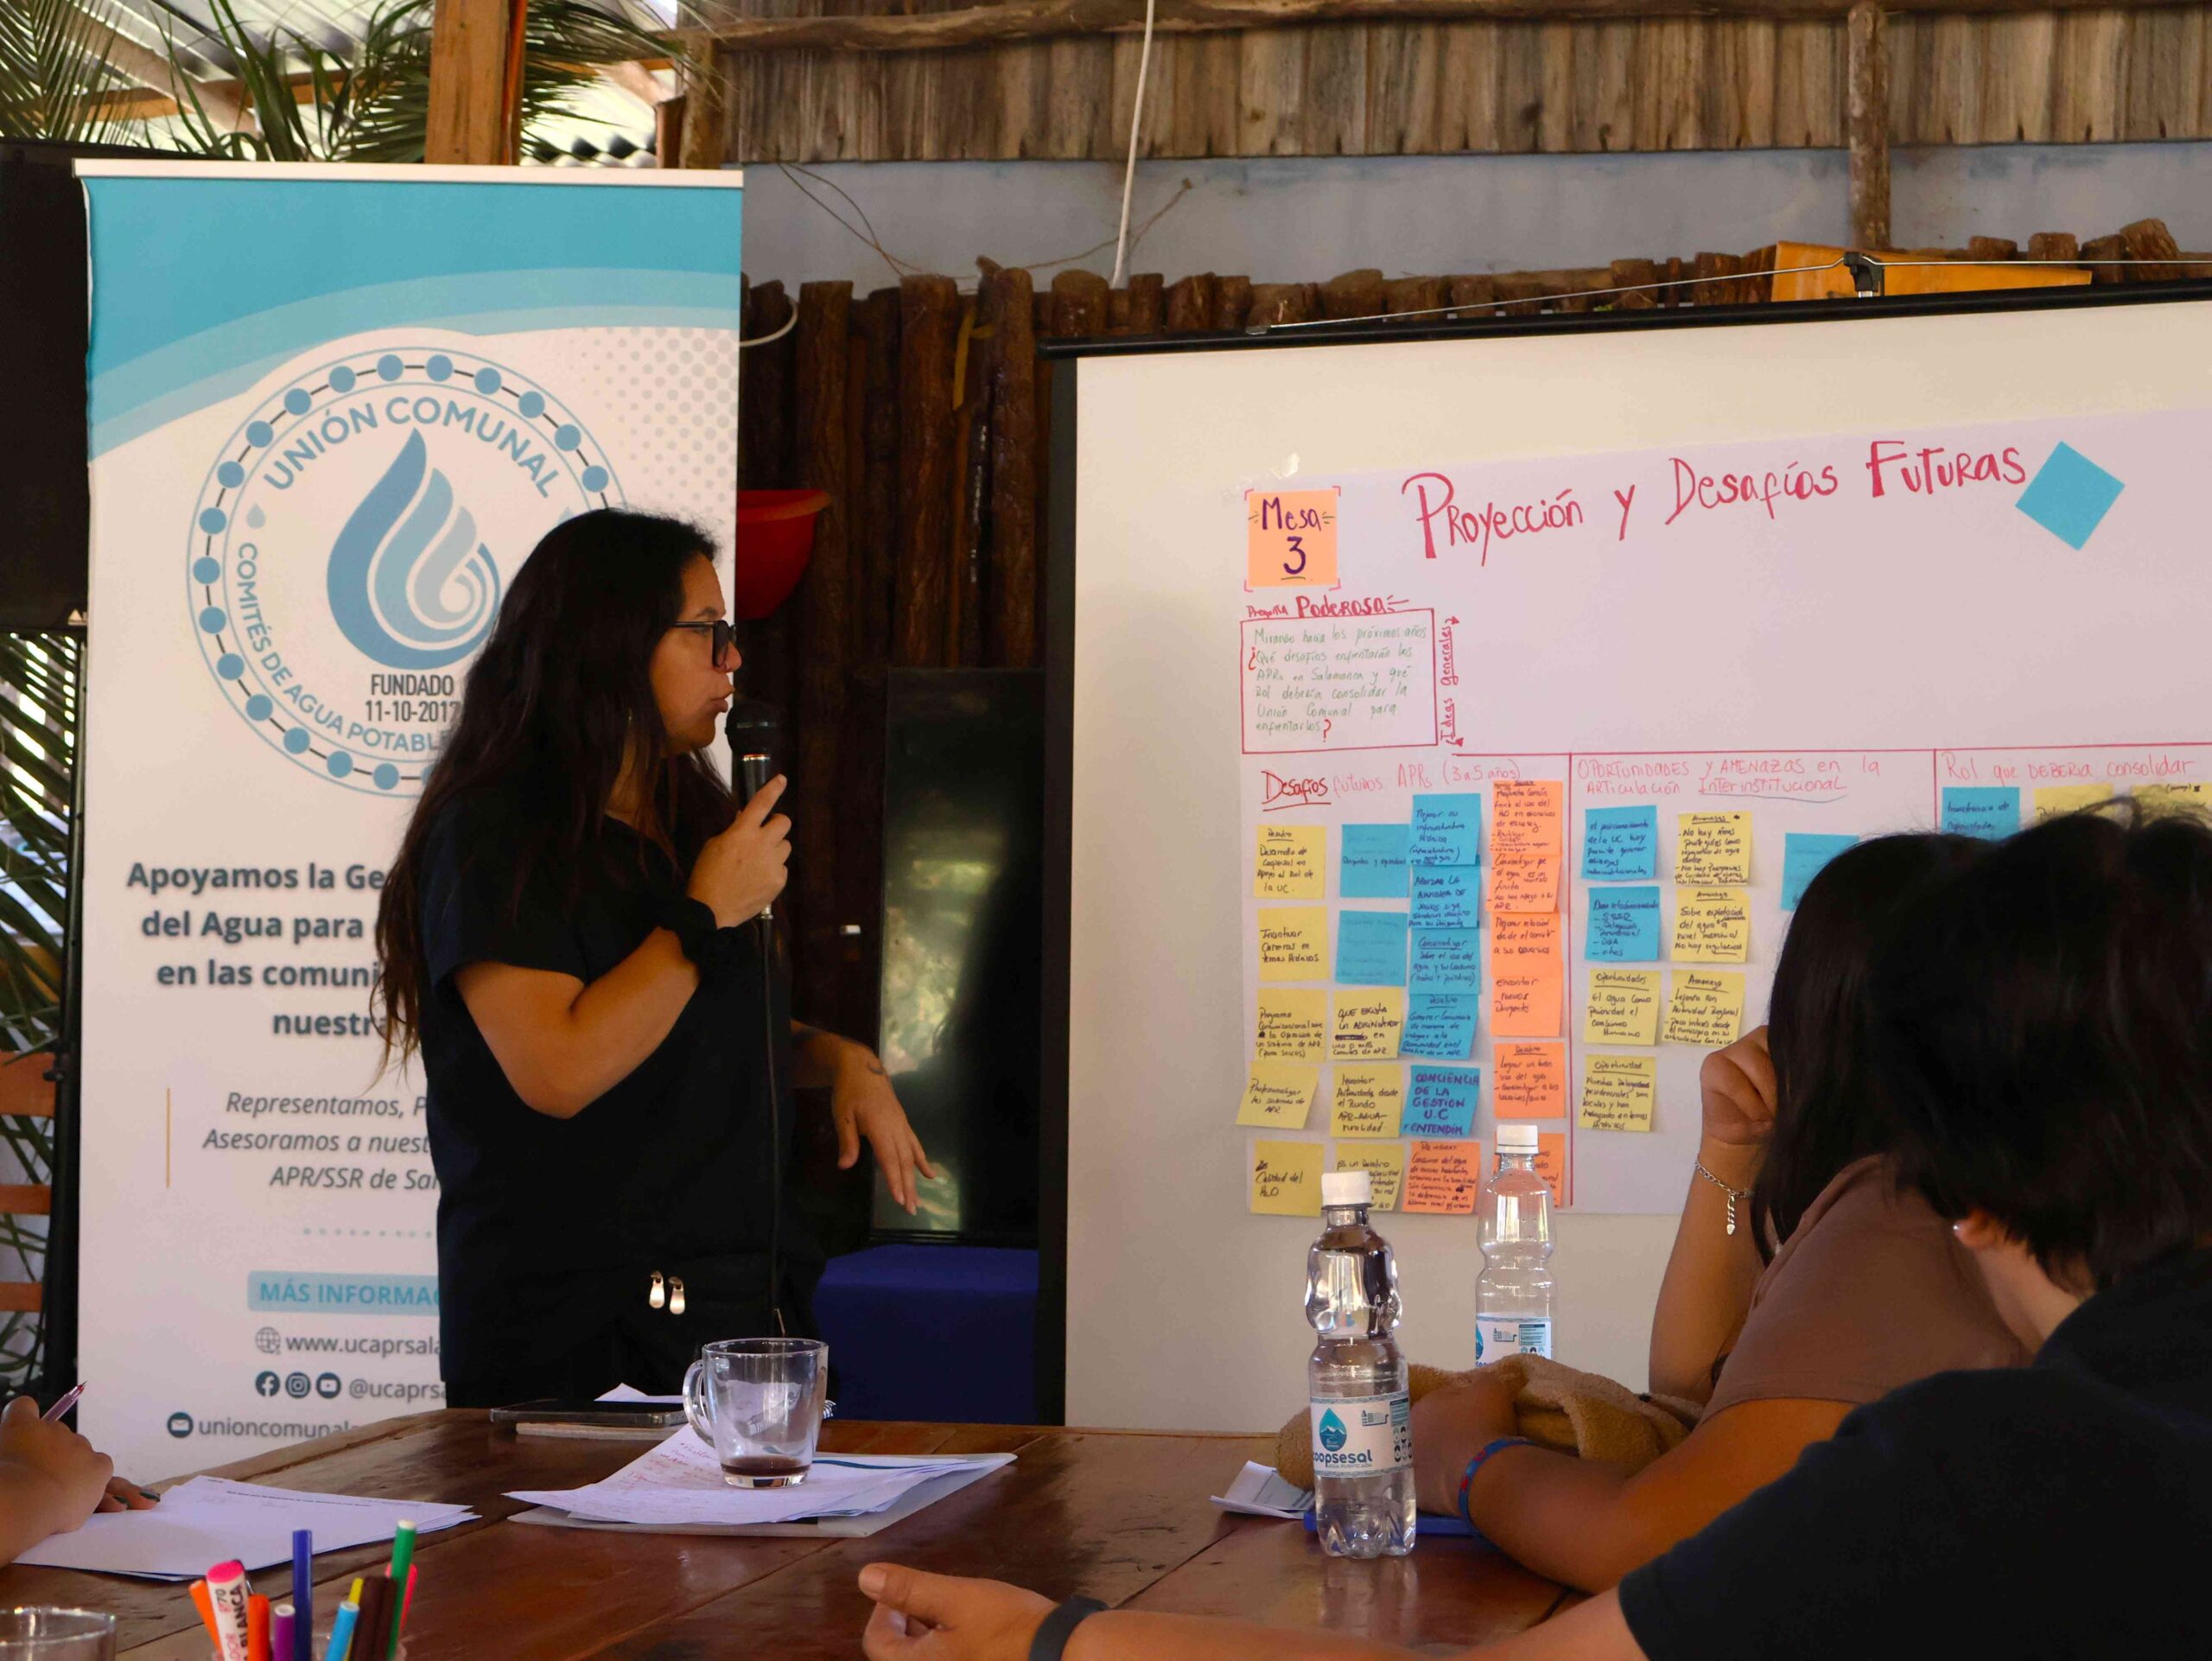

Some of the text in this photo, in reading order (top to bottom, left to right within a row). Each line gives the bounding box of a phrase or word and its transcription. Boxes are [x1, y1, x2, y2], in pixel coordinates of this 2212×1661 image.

[264, 397, 559, 498] UNIÓN COMUNAL
[1665, 457, 1838, 525] Desafíos
[1262, 496, 1322, 531] Mesa
[1283, 536, 1306, 575] 3
[237, 543, 271, 652] COMITÉS
[261, 652, 293, 687] DE
[285, 682, 342, 735] AGUA
[1404, 625, 1427, 640] años
[1439, 626, 1458, 685] generales
[371, 674, 454, 696] FUNDADO
[1311, 667, 1363, 682] Salamanca
[365, 700, 461, 722] 11-10-2017
[1256, 703, 1287, 717] Unión
[1306, 702, 1352, 718] Comunal
[1942, 752, 1978, 779] Rol
[127, 862, 299, 895] Apoyamos
[308, 862, 335, 889] la
[142, 910, 363, 945] del Agua para
[156, 964, 197, 985] en
[208, 958, 253, 986] las
[273, 1013, 388, 1036] nuestr
[1414, 1086, 1449, 1096] DE LA
[226, 1092, 404, 1119] Representamos,
[203, 1129, 340, 1151] Asesoramos
[347, 1135, 361, 1152] a
[270, 1166, 363, 1189] APR/SSR
[370, 1168, 397, 1189] de
[260, 1279, 310, 1303] MÁS
[349, 1379, 445, 1403] @ucaprs
[199, 1417, 359, 1438] unioncomunal
